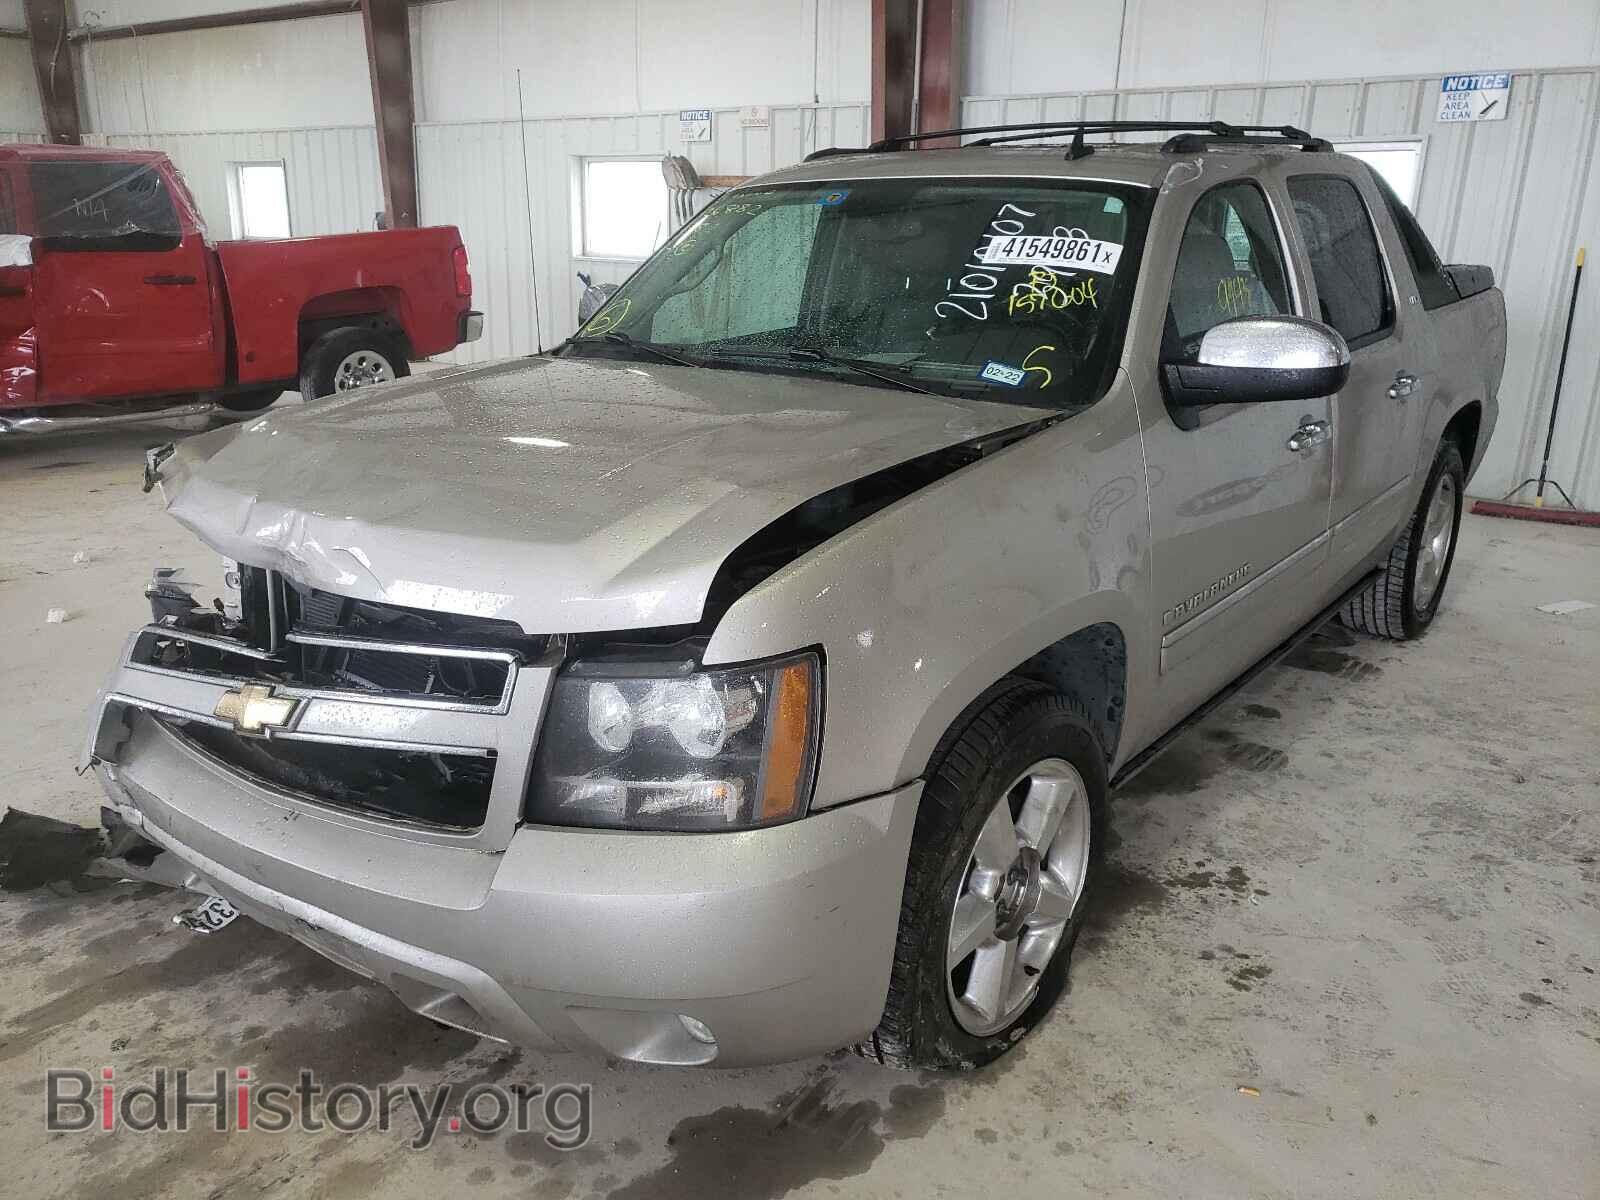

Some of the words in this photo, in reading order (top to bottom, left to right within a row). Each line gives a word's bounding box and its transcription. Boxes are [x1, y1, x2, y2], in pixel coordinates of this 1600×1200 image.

[1446, 75, 1507, 91] NOTICE
[1446, 92, 1470, 101] KEEP
[1445, 101, 1469, 111] AREA
[681, 111, 709, 120] NOTICE
[1441, 111, 1471, 120] CLEAN
[1002, 237, 1102, 263] 41549861
